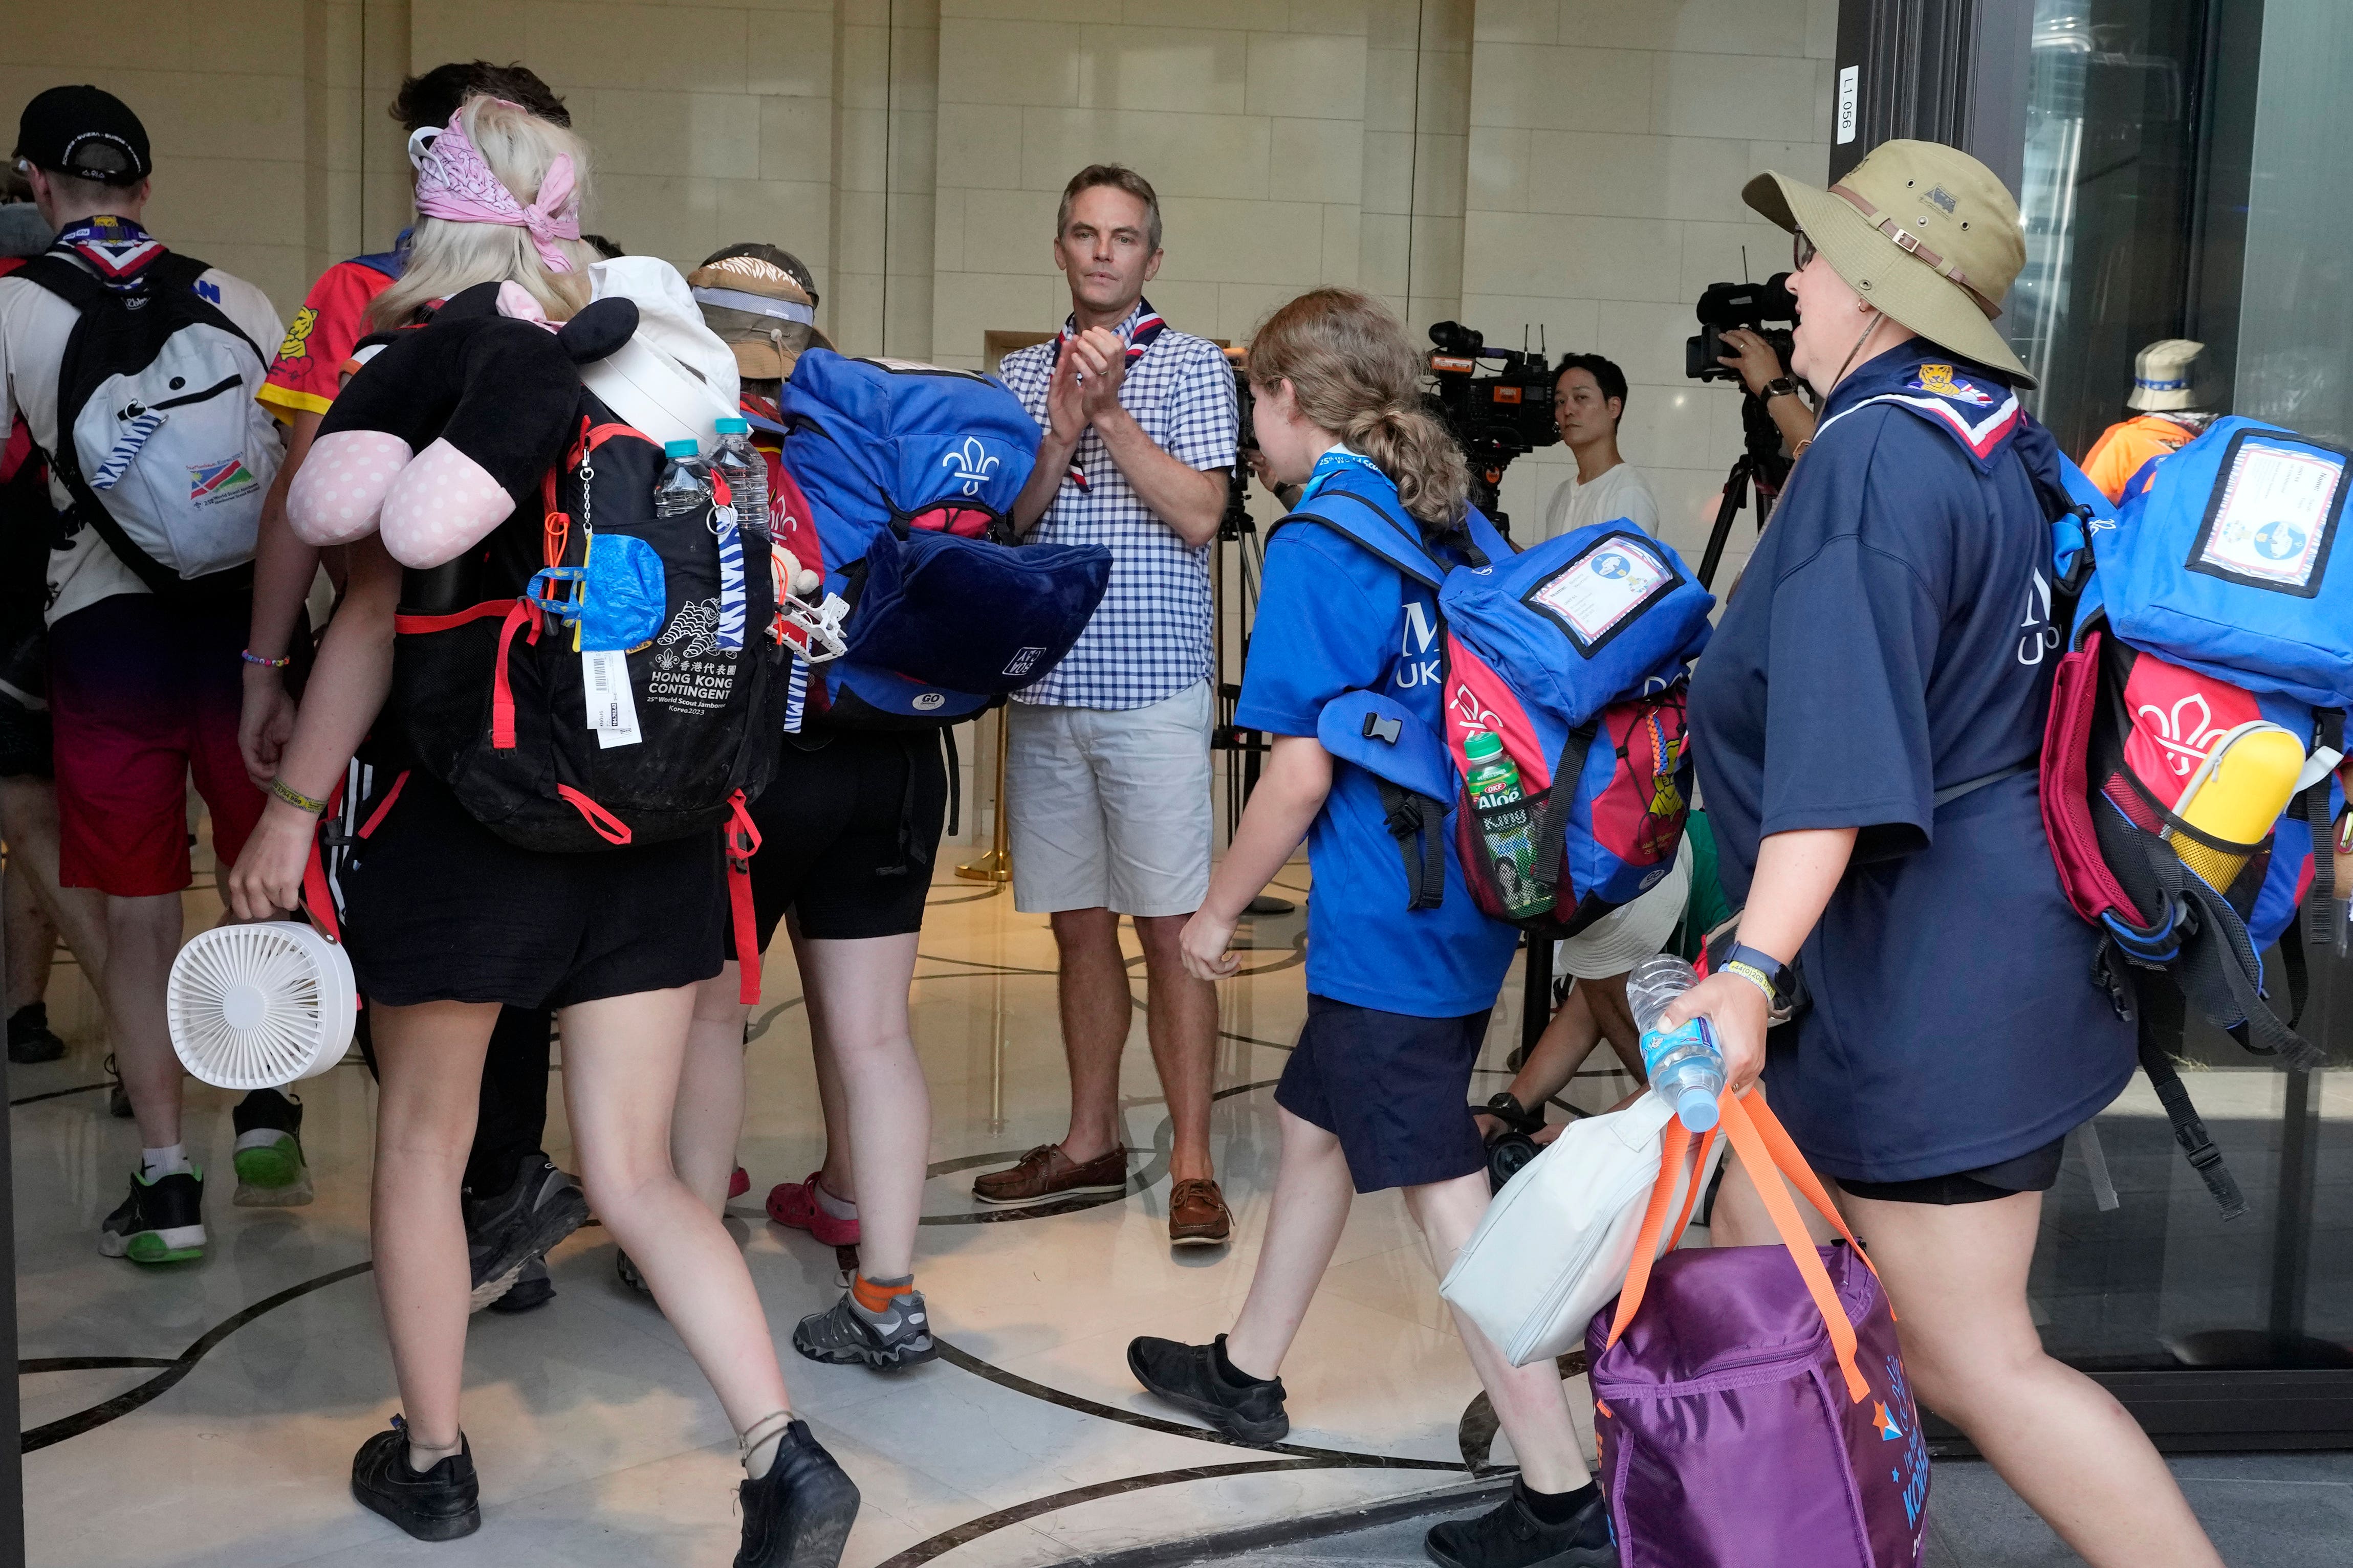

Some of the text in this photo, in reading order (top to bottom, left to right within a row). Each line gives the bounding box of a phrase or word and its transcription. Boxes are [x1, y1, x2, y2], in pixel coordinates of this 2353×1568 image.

[1319, 456, 1335, 466] 25th
[679, 660, 737, 676] 香港代表團
[651, 671, 733, 689] HONG KONG
[648, 682, 731, 700] CONTINGENT
[678, 698, 697, 707] Scout
[922, 694, 940, 702] GO
[1488, 783, 1503, 792] OKF
